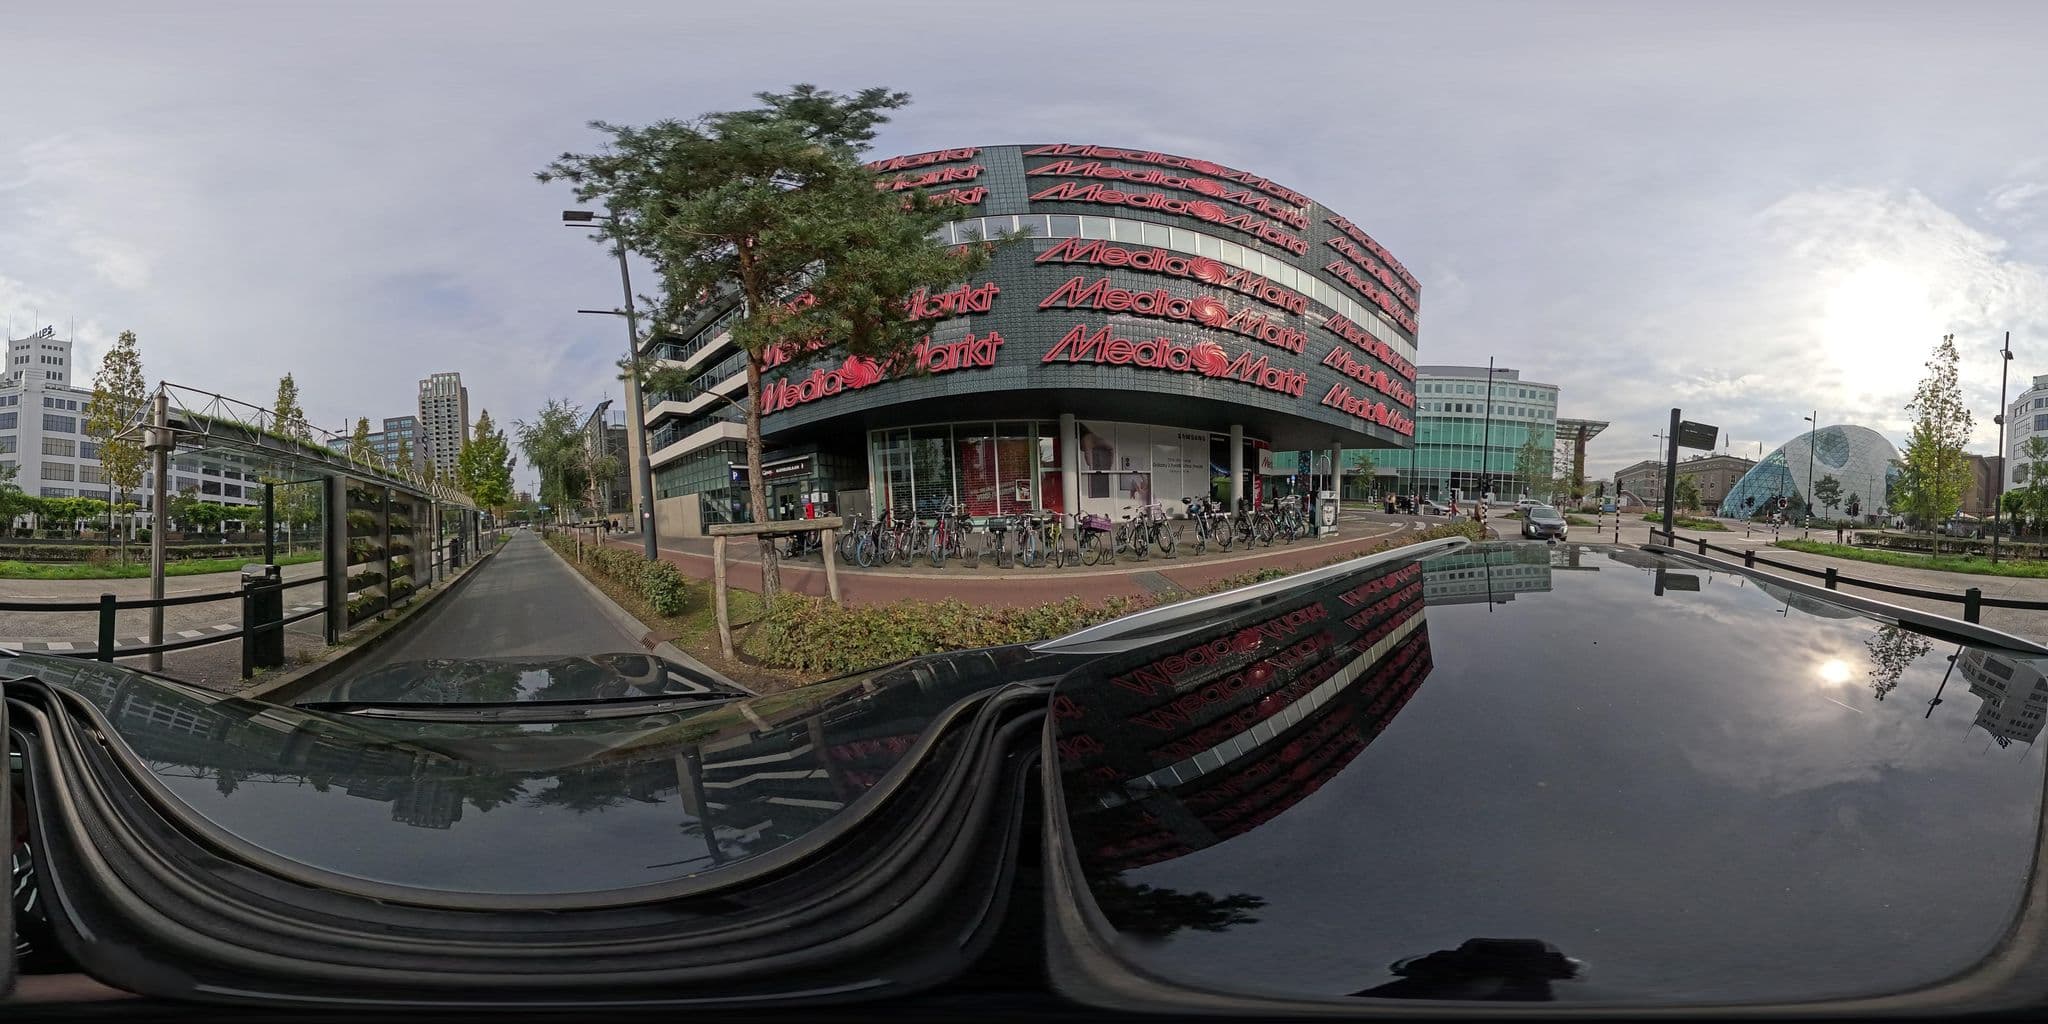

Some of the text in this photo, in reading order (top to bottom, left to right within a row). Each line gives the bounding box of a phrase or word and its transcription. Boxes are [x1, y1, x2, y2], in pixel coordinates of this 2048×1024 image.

[1023, 143, 1312, 209] Media Markt
[1026, 160, 1311, 231] Media Markt
[1029, 182, 1310, 256] Media Markt
[1035, 237, 1307, 316] Media Markt
[1039, 276, 1308, 354] Media Markt
[760, 368, 842, 415] Media
[1041, 323, 1308, 397] Media Markt
[1323, 345, 1376, 388] Media
[1321, 382, 1415, 436] Media Markt
[732, 471, 738, 480] P
